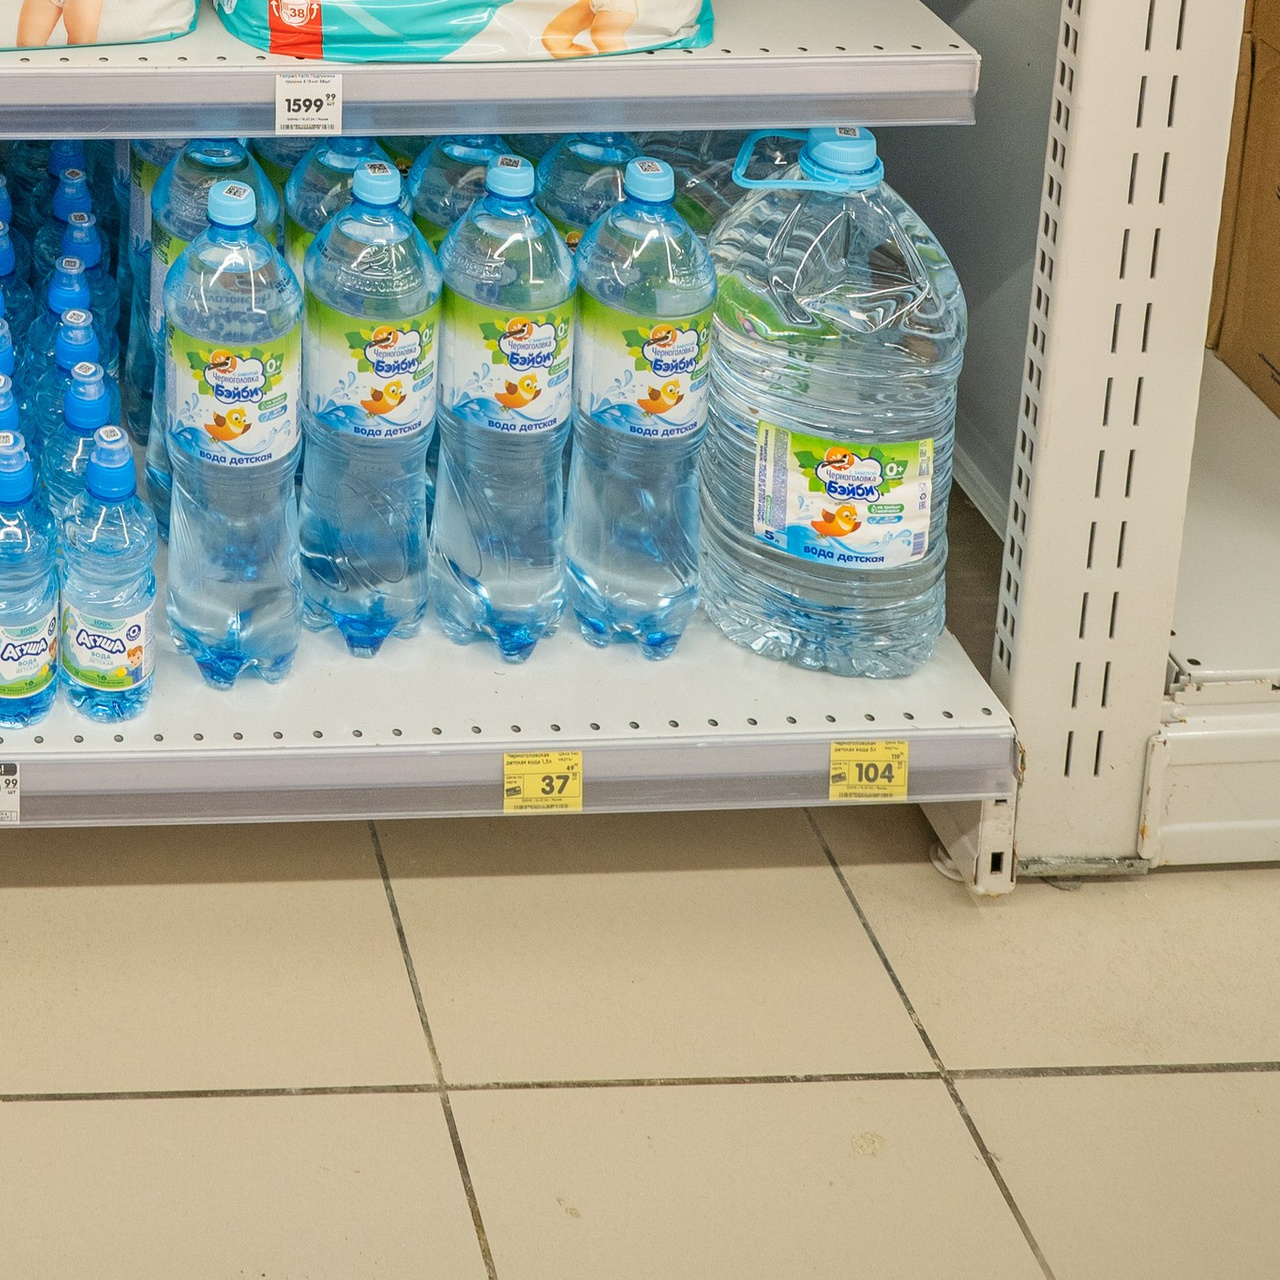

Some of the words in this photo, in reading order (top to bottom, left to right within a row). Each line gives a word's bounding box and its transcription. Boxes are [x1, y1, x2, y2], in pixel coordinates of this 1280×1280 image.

[354, 425, 381, 437] вода
[384, 421, 421, 437] детская
[828, 482, 874, 496] Бэйби
[856, 764, 894, 783] 104
[541, 775, 569, 794] 37
